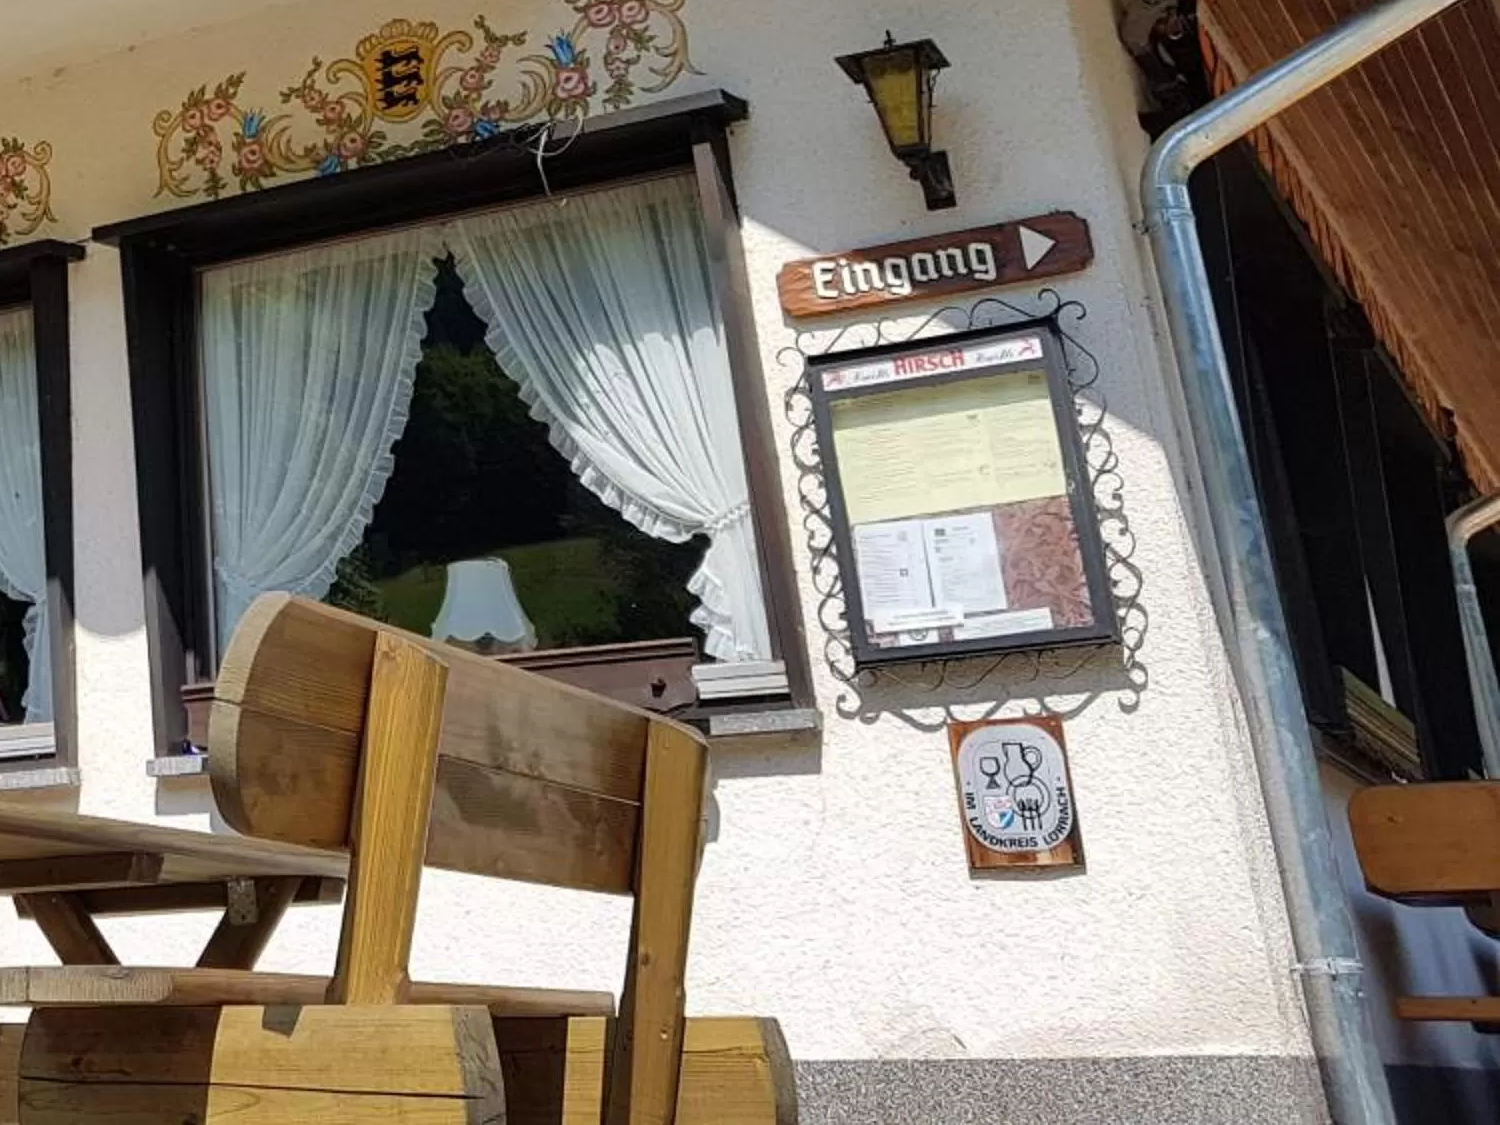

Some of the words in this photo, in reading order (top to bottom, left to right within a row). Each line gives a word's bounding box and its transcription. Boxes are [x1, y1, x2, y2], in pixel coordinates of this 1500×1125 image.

[812, 241, 997, 299] Eingang
[893, 350, 965, 376] HIRSCH
[965, 792, 977, 810] IM
[969, 816, 1038, 849] LANDKREIS
